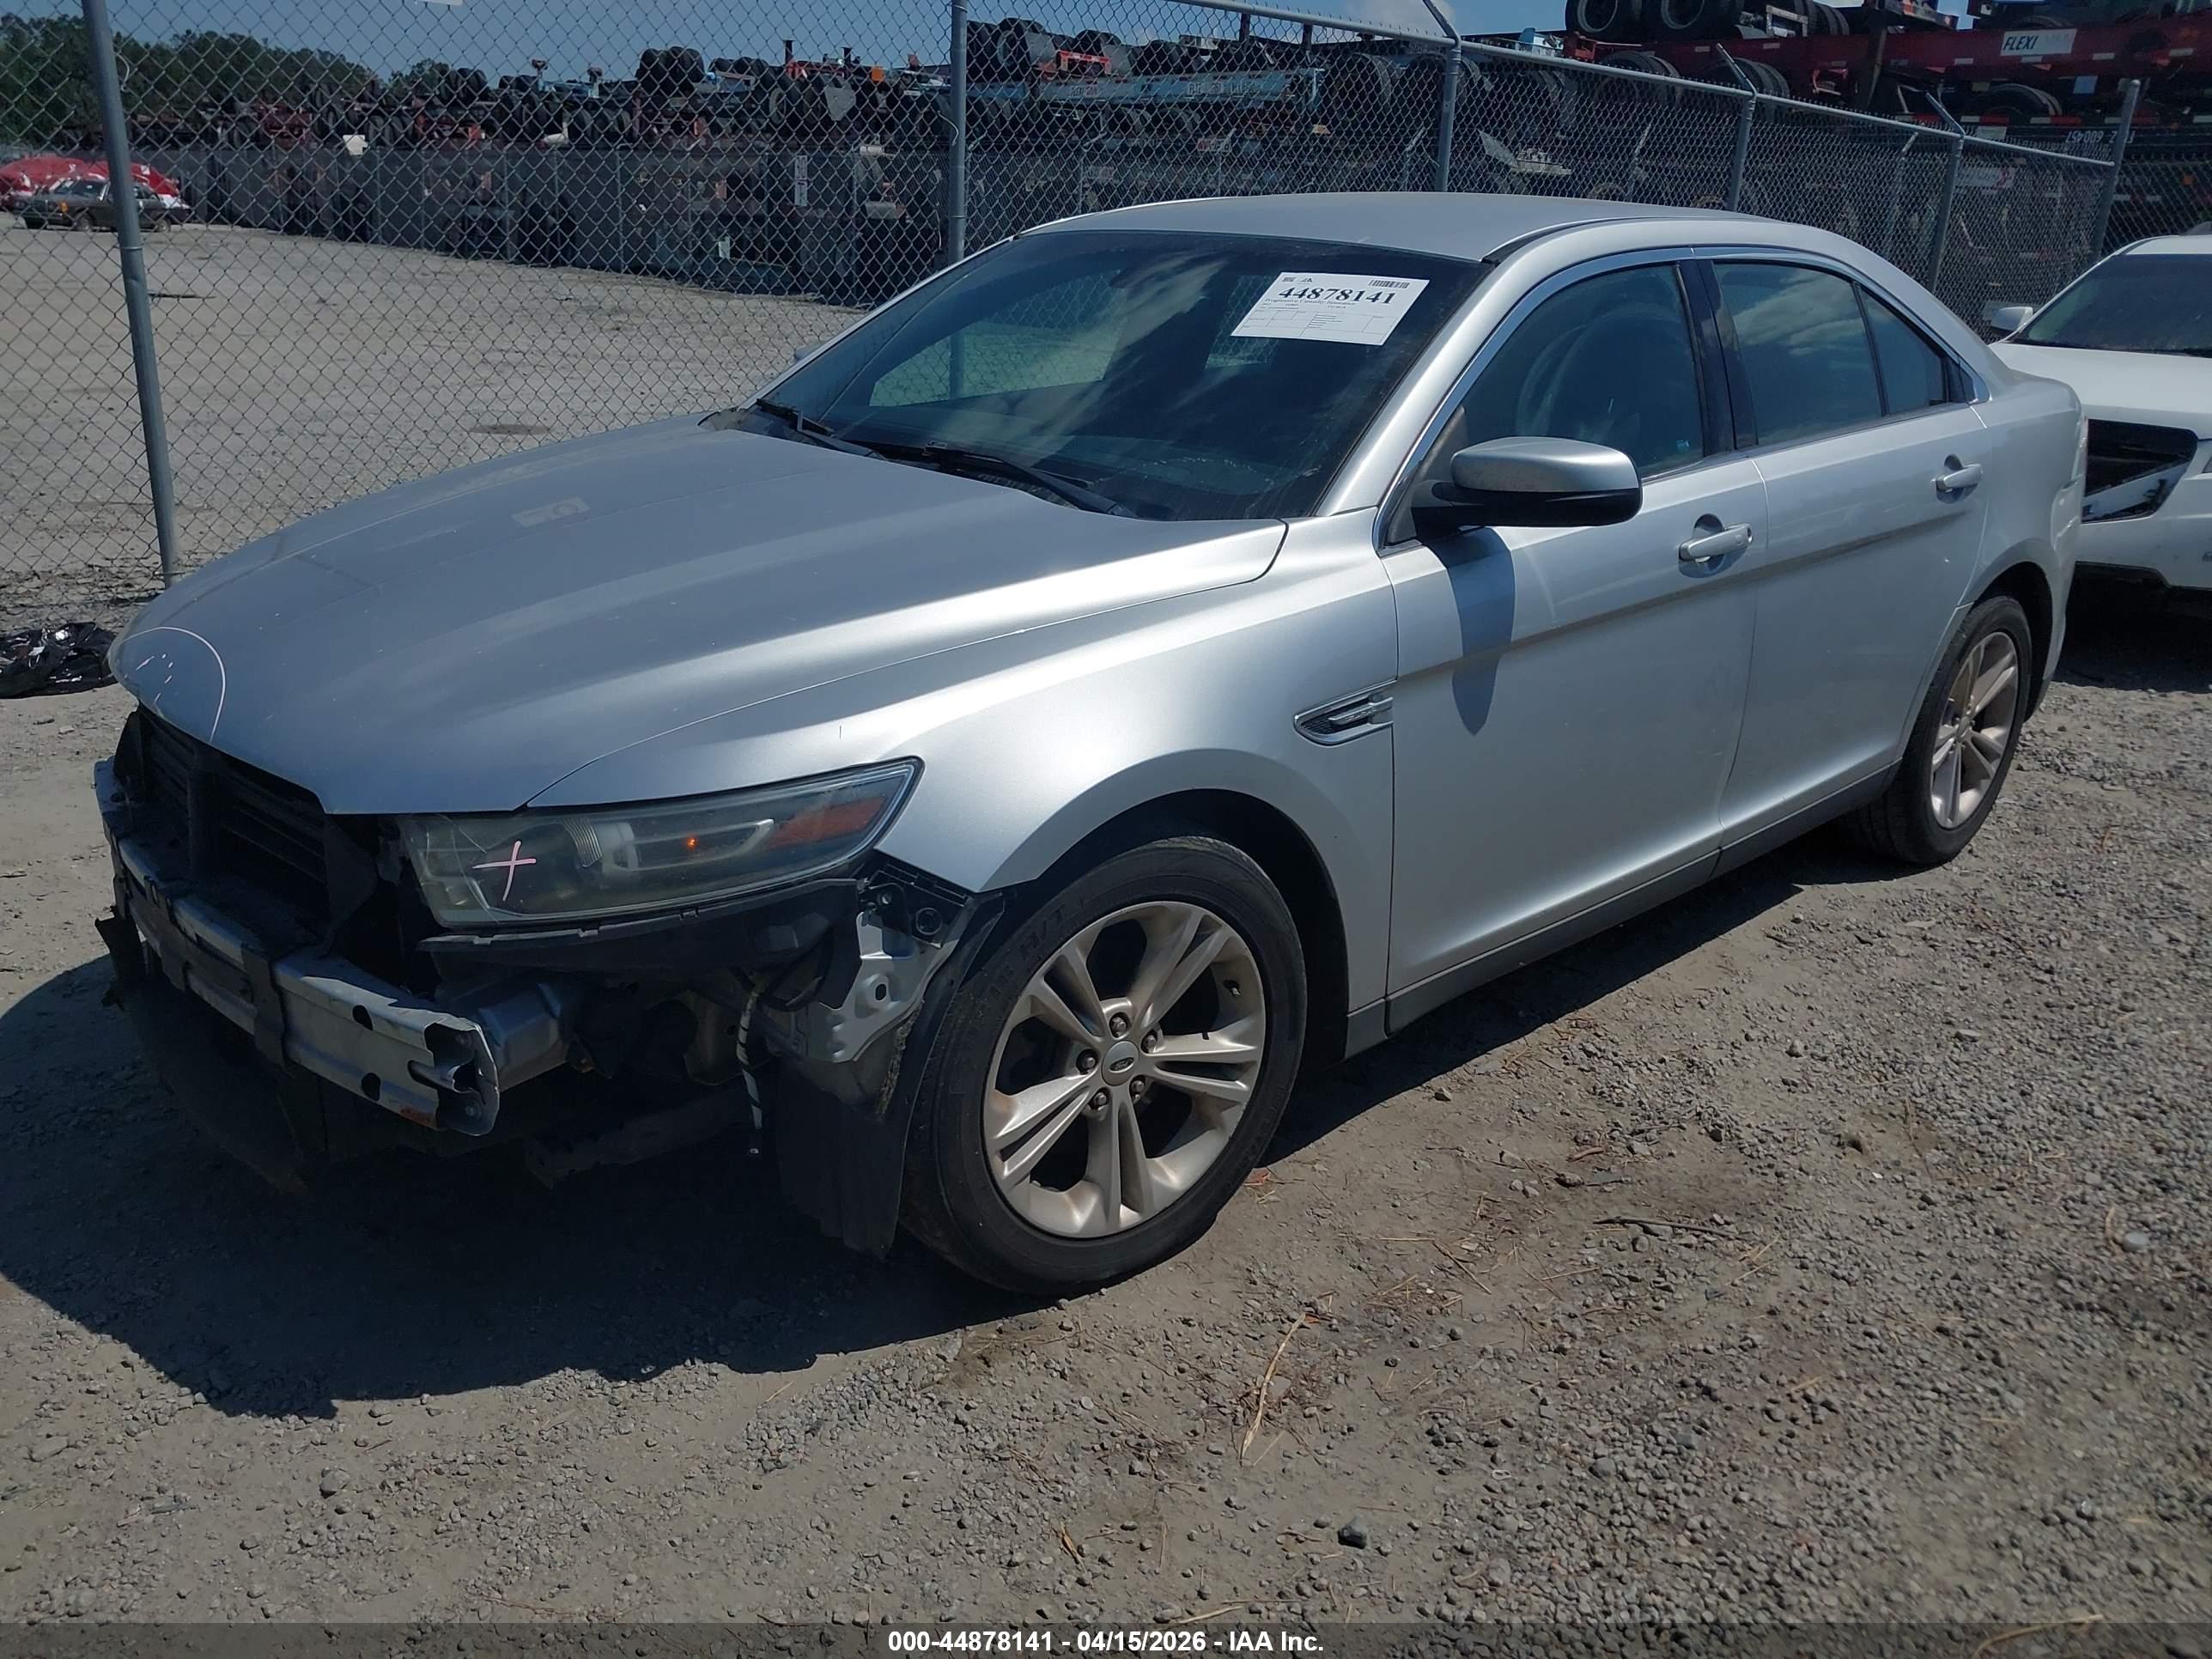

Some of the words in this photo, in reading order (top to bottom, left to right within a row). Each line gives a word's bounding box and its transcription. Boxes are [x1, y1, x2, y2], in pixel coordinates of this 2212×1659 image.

[2003, 35, 2039, 51] FLEXI
[2109, 131, 2136, 143] FZ
[1279, 287, 1395, 303] 44878141
